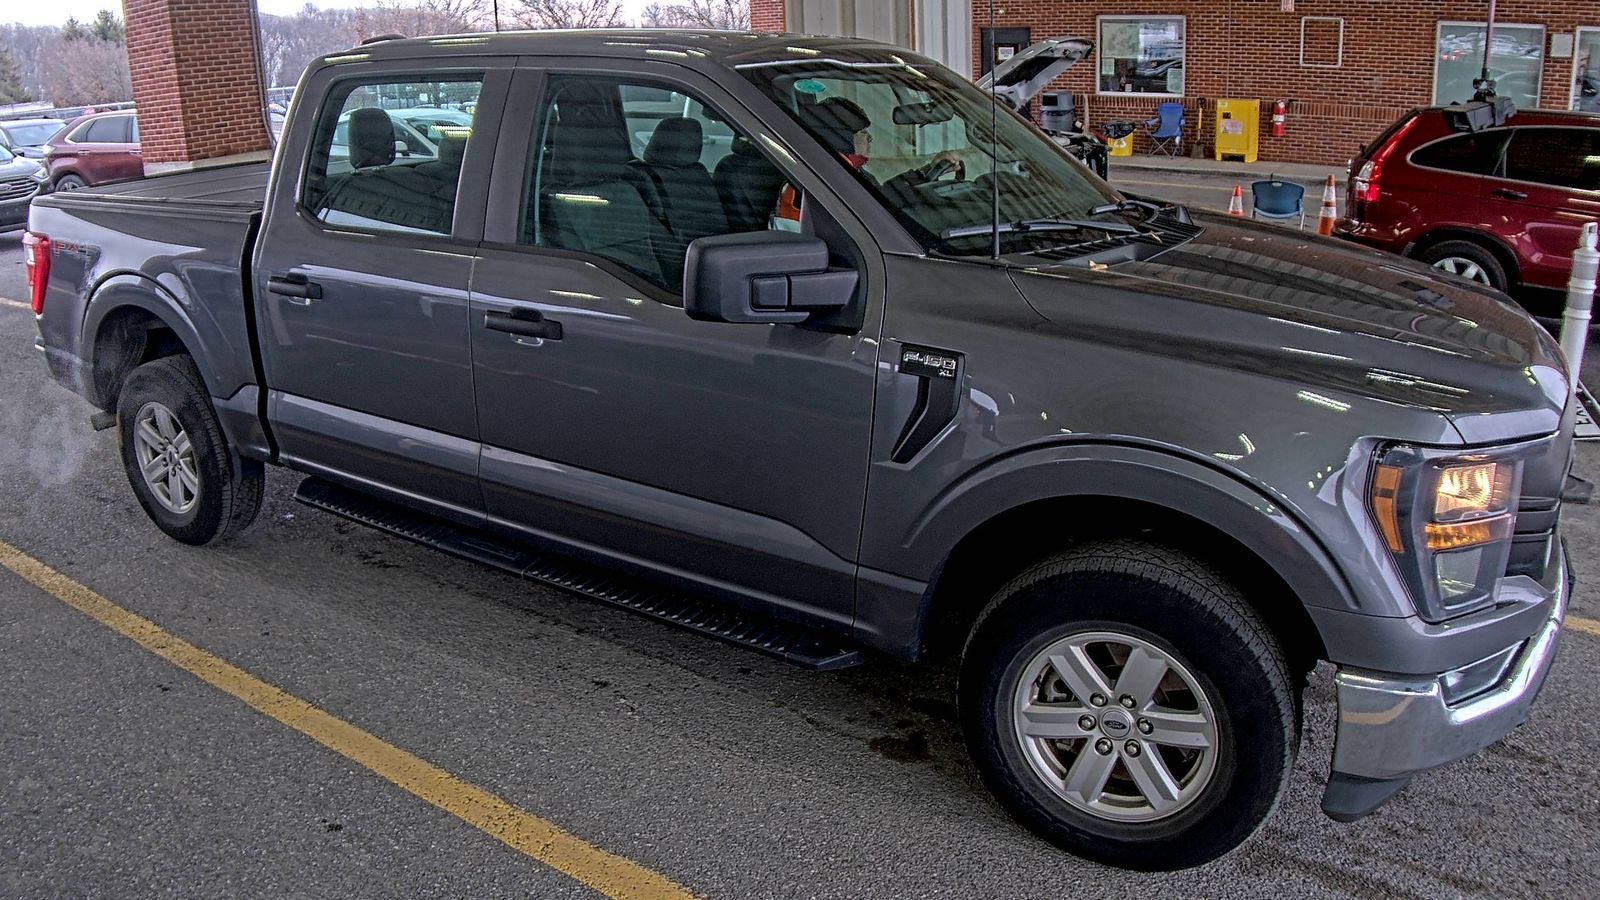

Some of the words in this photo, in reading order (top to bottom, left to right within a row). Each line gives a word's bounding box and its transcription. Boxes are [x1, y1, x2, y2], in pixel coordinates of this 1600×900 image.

[903, 351, 956, 369] F-150
[938, 368, 953, 377] XL
[1106, 720, 1125, 729] Ford
